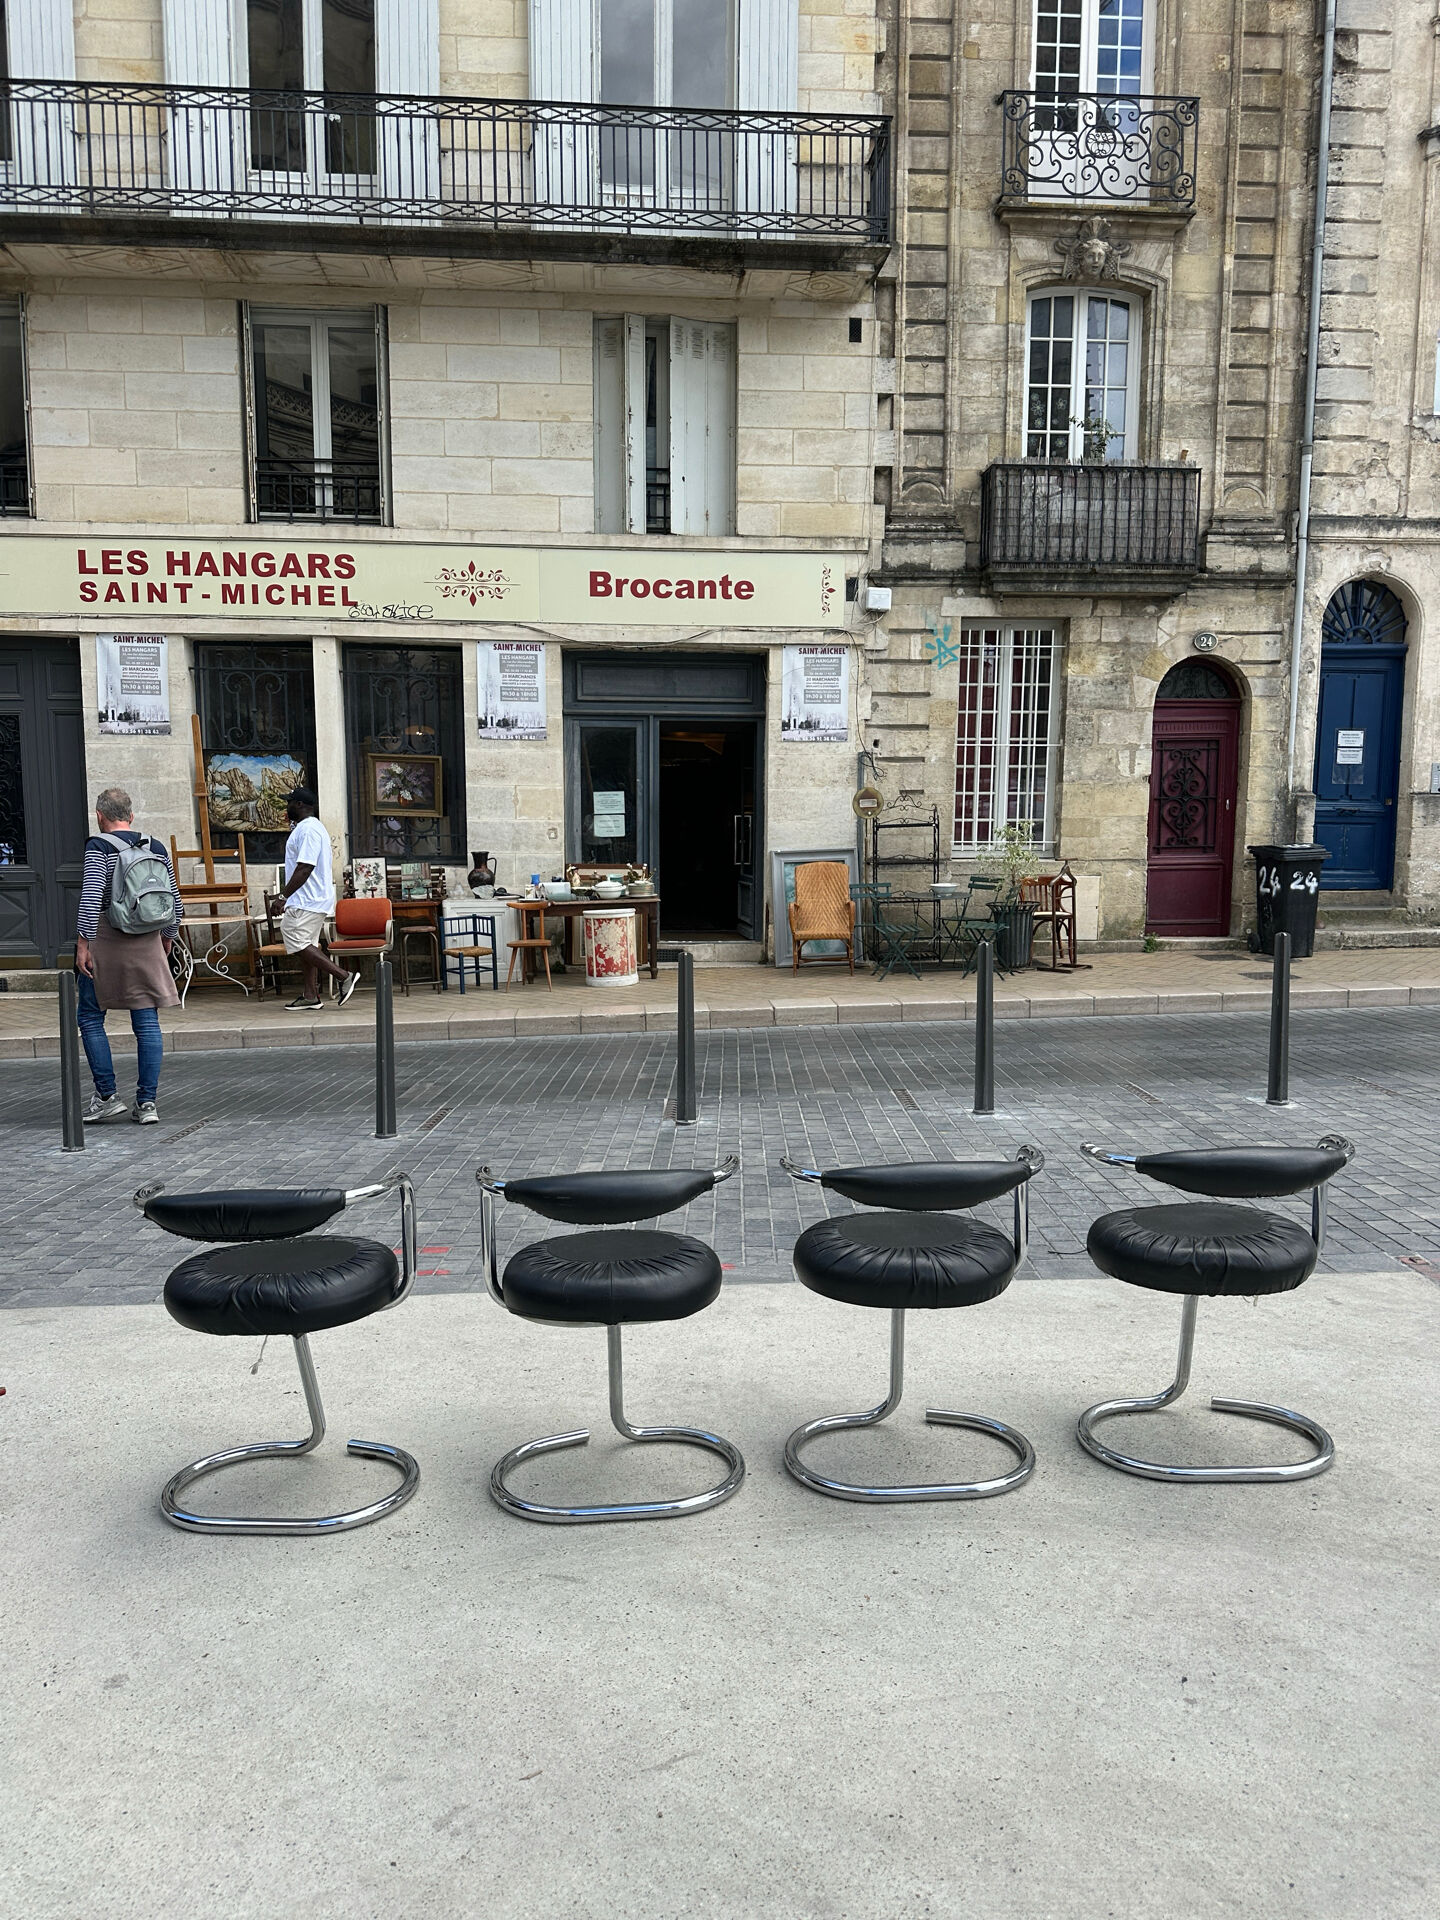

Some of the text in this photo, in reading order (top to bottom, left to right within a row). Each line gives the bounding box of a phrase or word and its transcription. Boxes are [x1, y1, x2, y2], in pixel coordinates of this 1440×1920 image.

[77, 549, 357, 579] LES HANGARS
[589, 571, 755, 600] Brocante
[113, 635, 165, 644] SAINT-MICHEL
[493, 643, 542, 652] SAINT-MICHEL
[1200, 636, 1213, 647] 24
[798, 647, 846, 655] SAINT-MICHEL
[1260, 866, 1281, 897] 24
[1290, 871, 1318, 894] 24
